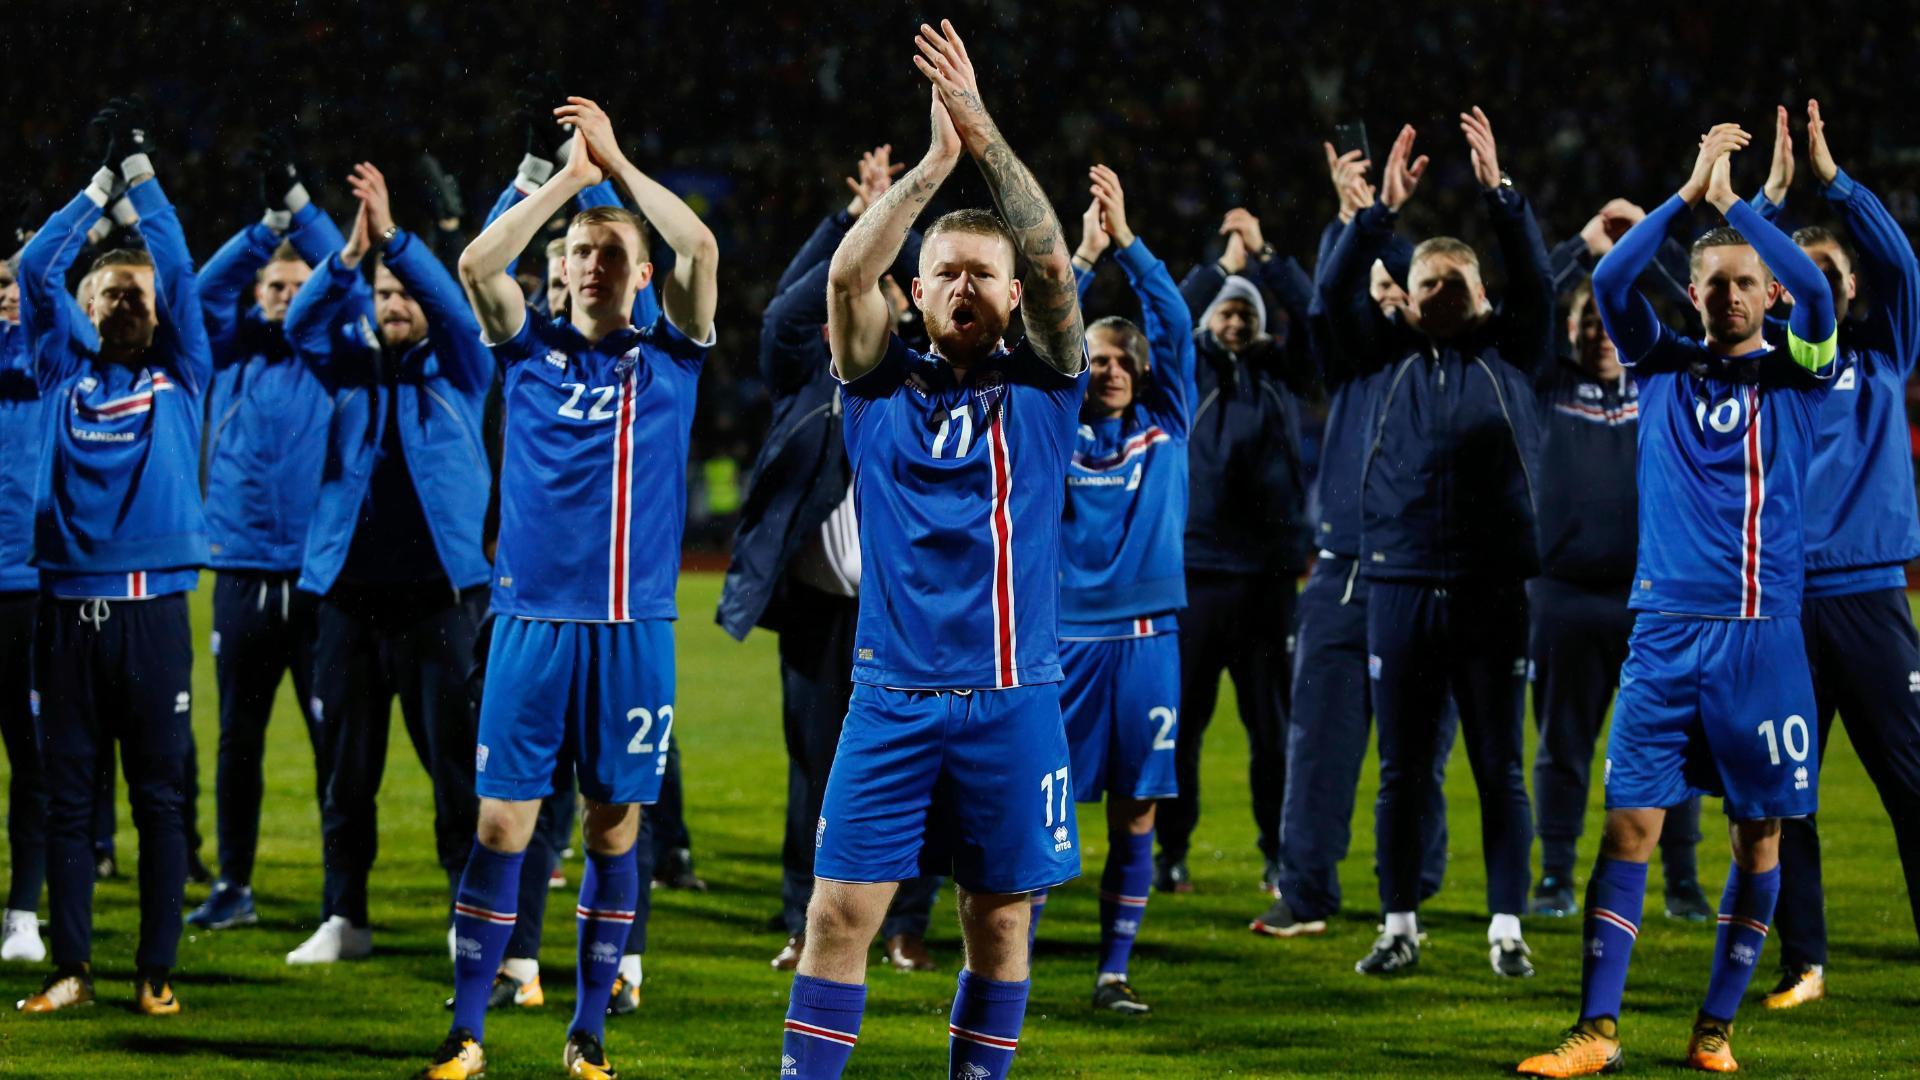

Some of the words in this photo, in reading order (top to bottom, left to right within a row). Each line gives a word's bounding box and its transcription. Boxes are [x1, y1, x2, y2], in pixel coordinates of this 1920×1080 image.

[557, 382, 616, 421] 22
[626, 704, 675, 755] 22
[1148, 705, 1178, 751] 2
[1756, 714, 1810, 766] 10
[1040, 765, 1069, 828] 17
